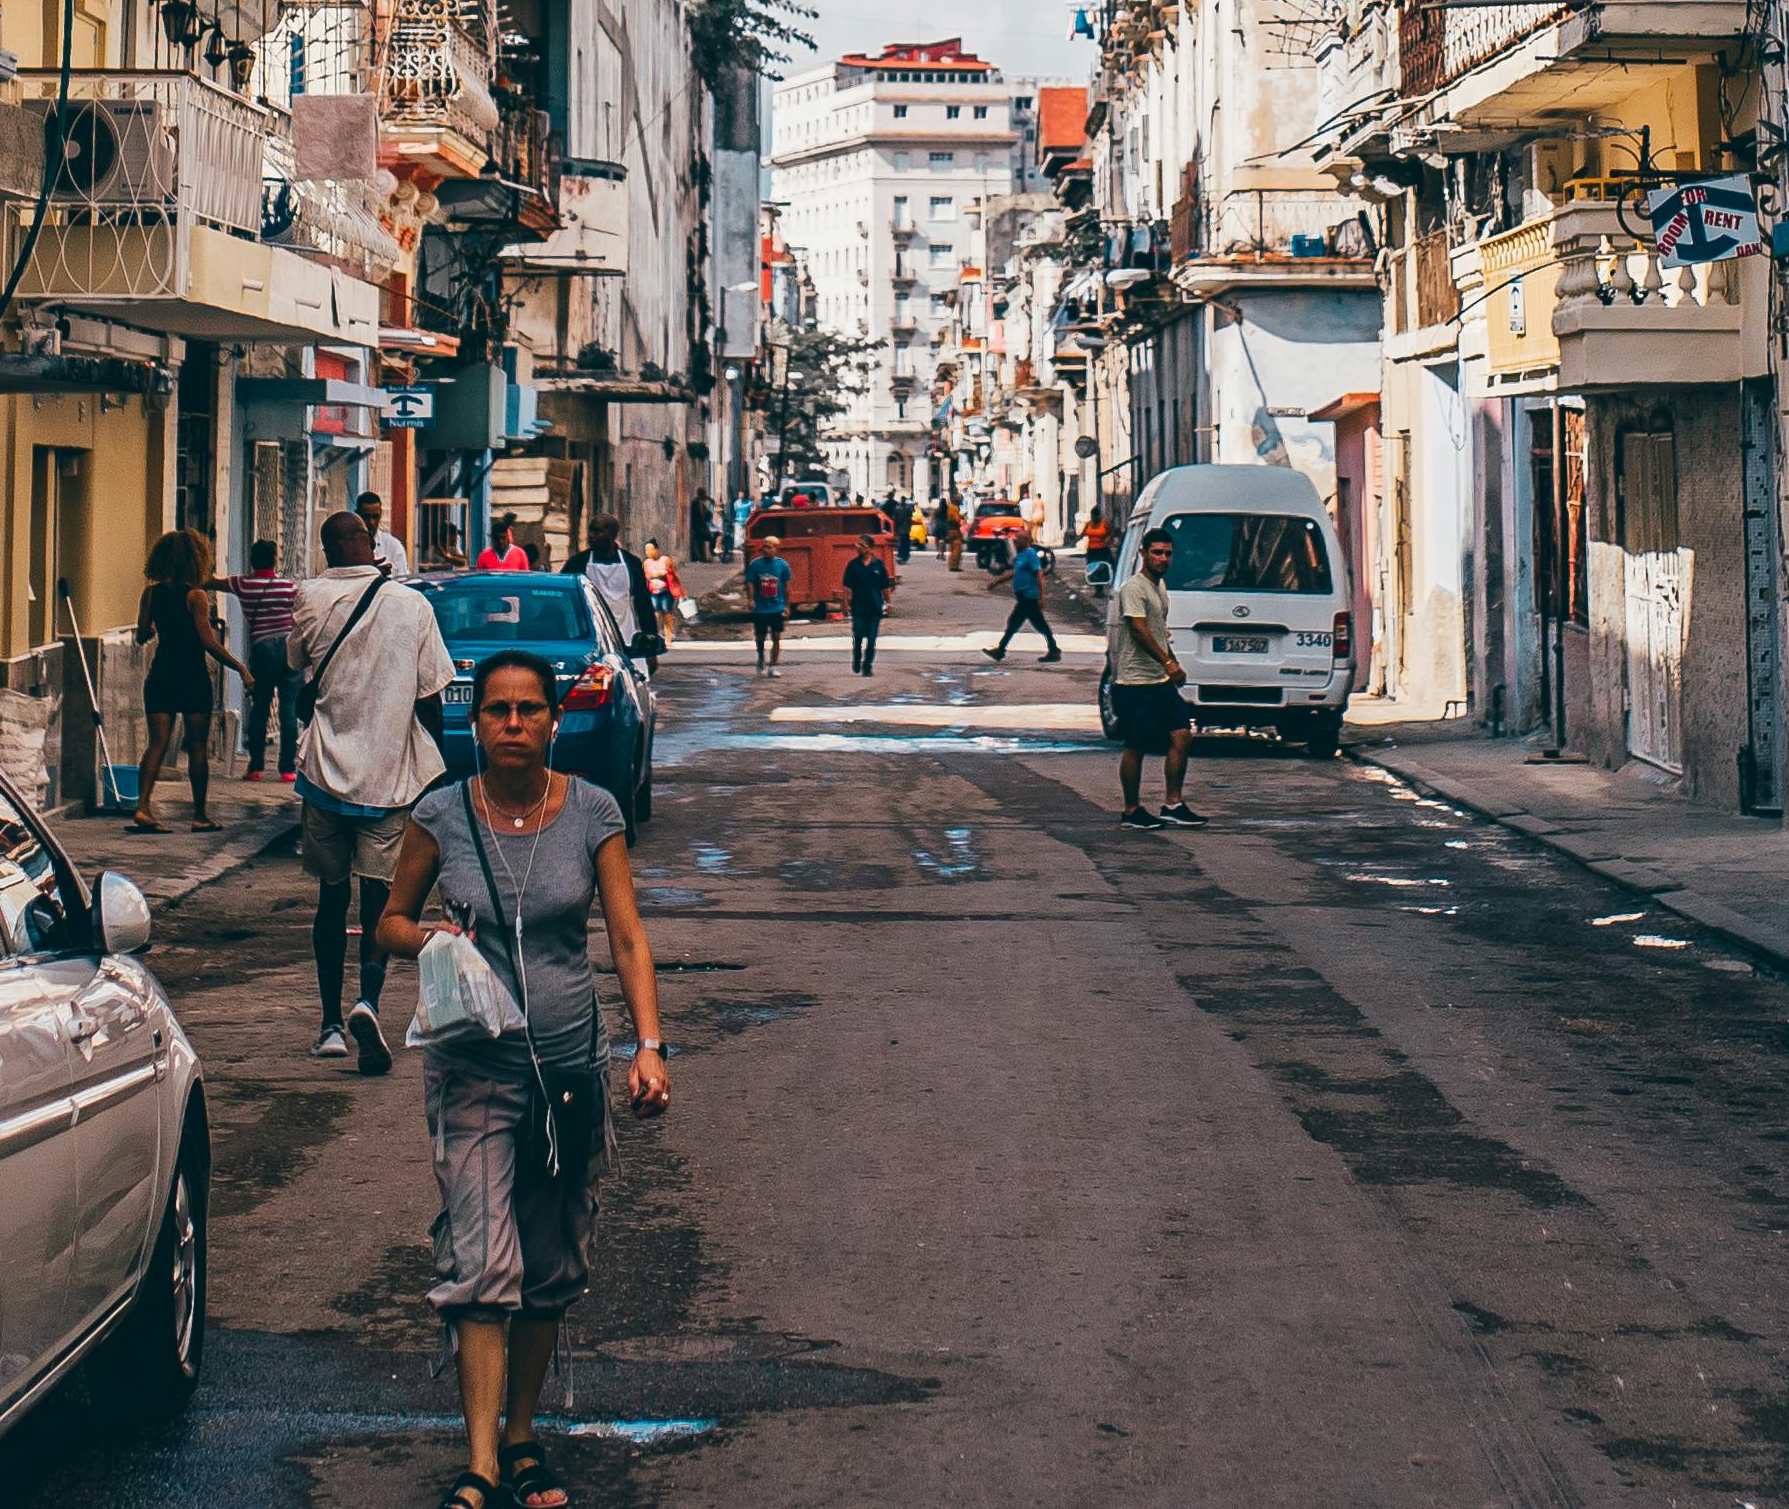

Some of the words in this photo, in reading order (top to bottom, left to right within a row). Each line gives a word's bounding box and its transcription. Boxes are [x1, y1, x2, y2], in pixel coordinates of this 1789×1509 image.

[1680, 188, 1708, 206] FOR
[1704, 209, 1743, 231] RENT
[1657, 210, 1689, 257] ROOM
[1296, 633, 1332, 647] 3340
